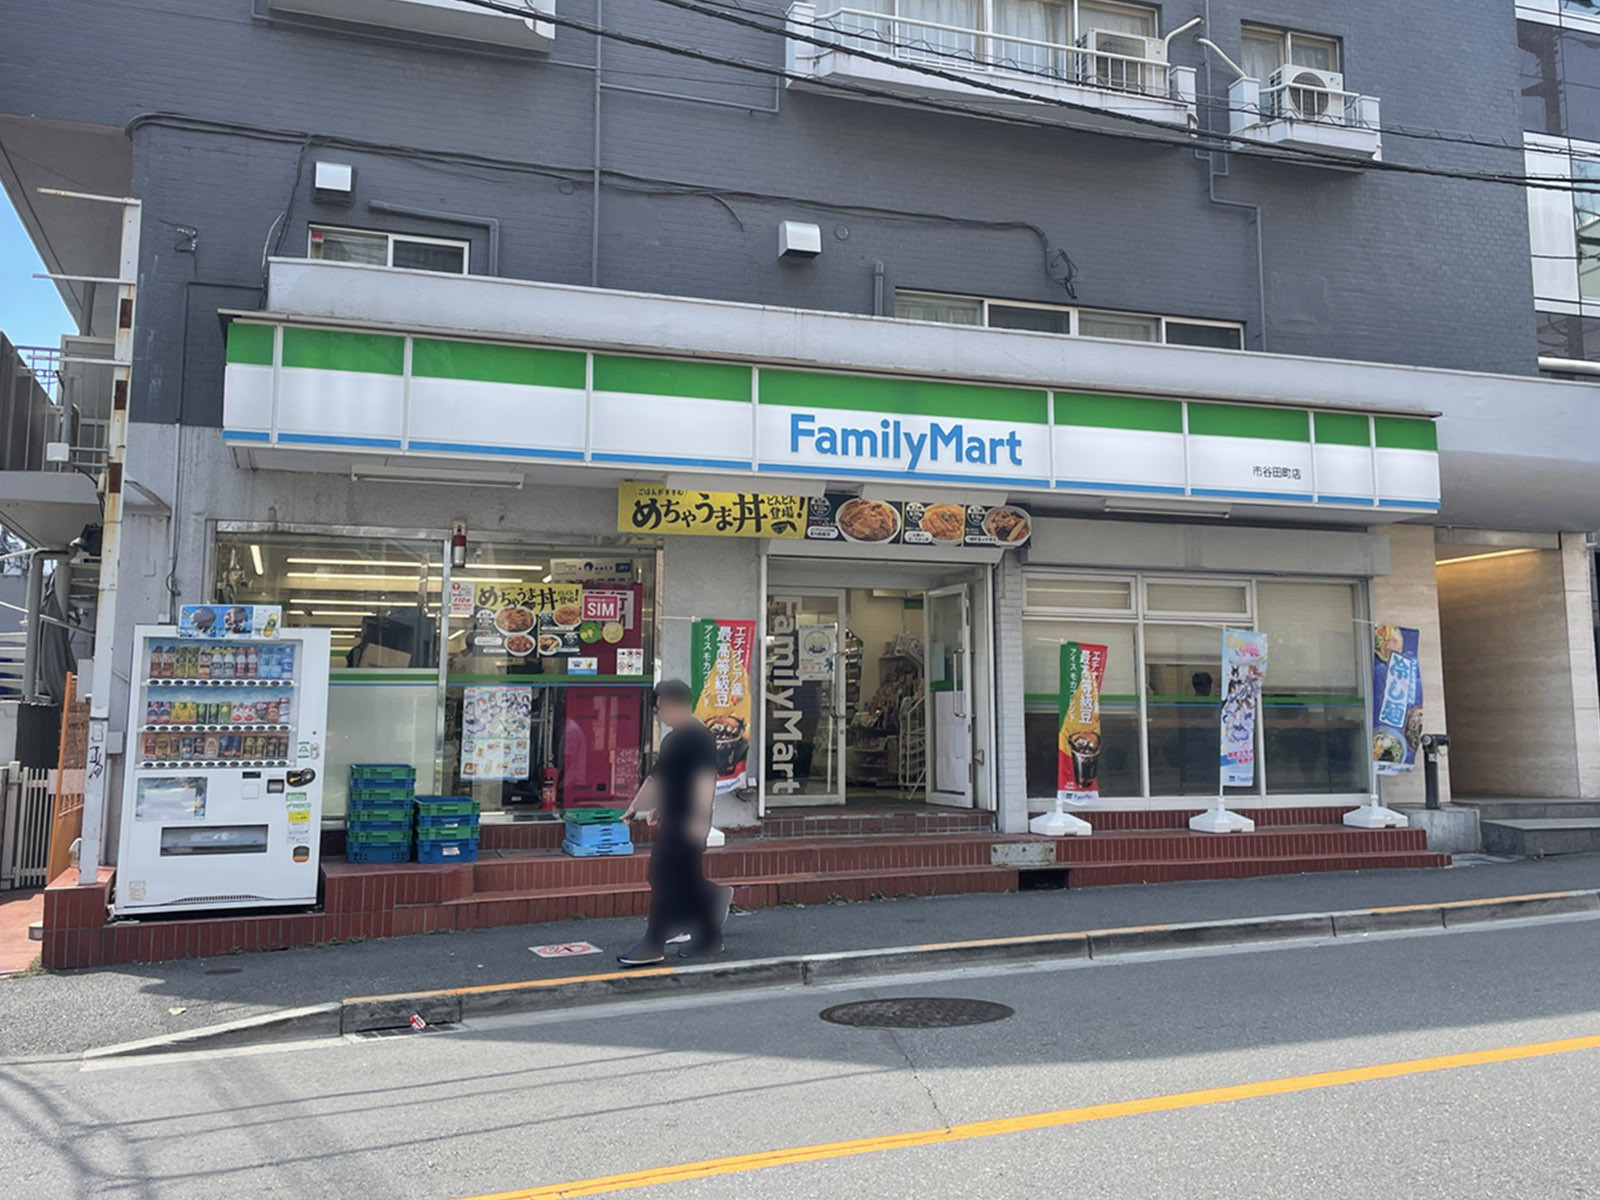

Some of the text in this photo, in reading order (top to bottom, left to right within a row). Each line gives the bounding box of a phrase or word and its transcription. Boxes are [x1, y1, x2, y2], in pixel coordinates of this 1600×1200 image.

[791, 413, 1022, 472] FamilyMart
[1252, 466, 1301, 480] 市谷田町店
[632, 492, 768, 534] めちゃうま丼
[767, 495, 797, 506] どんどん
[587, 602, 614, 617] SIM
[702, 625, 713, 650] アイス
[731, 626, 747, 697] エチオピア産
[714, 626, 733, 707] 最高等級豆
[1380, 653, 1410, 727] 冷し麺
[766, 596, 803, 794] FamilyMart
